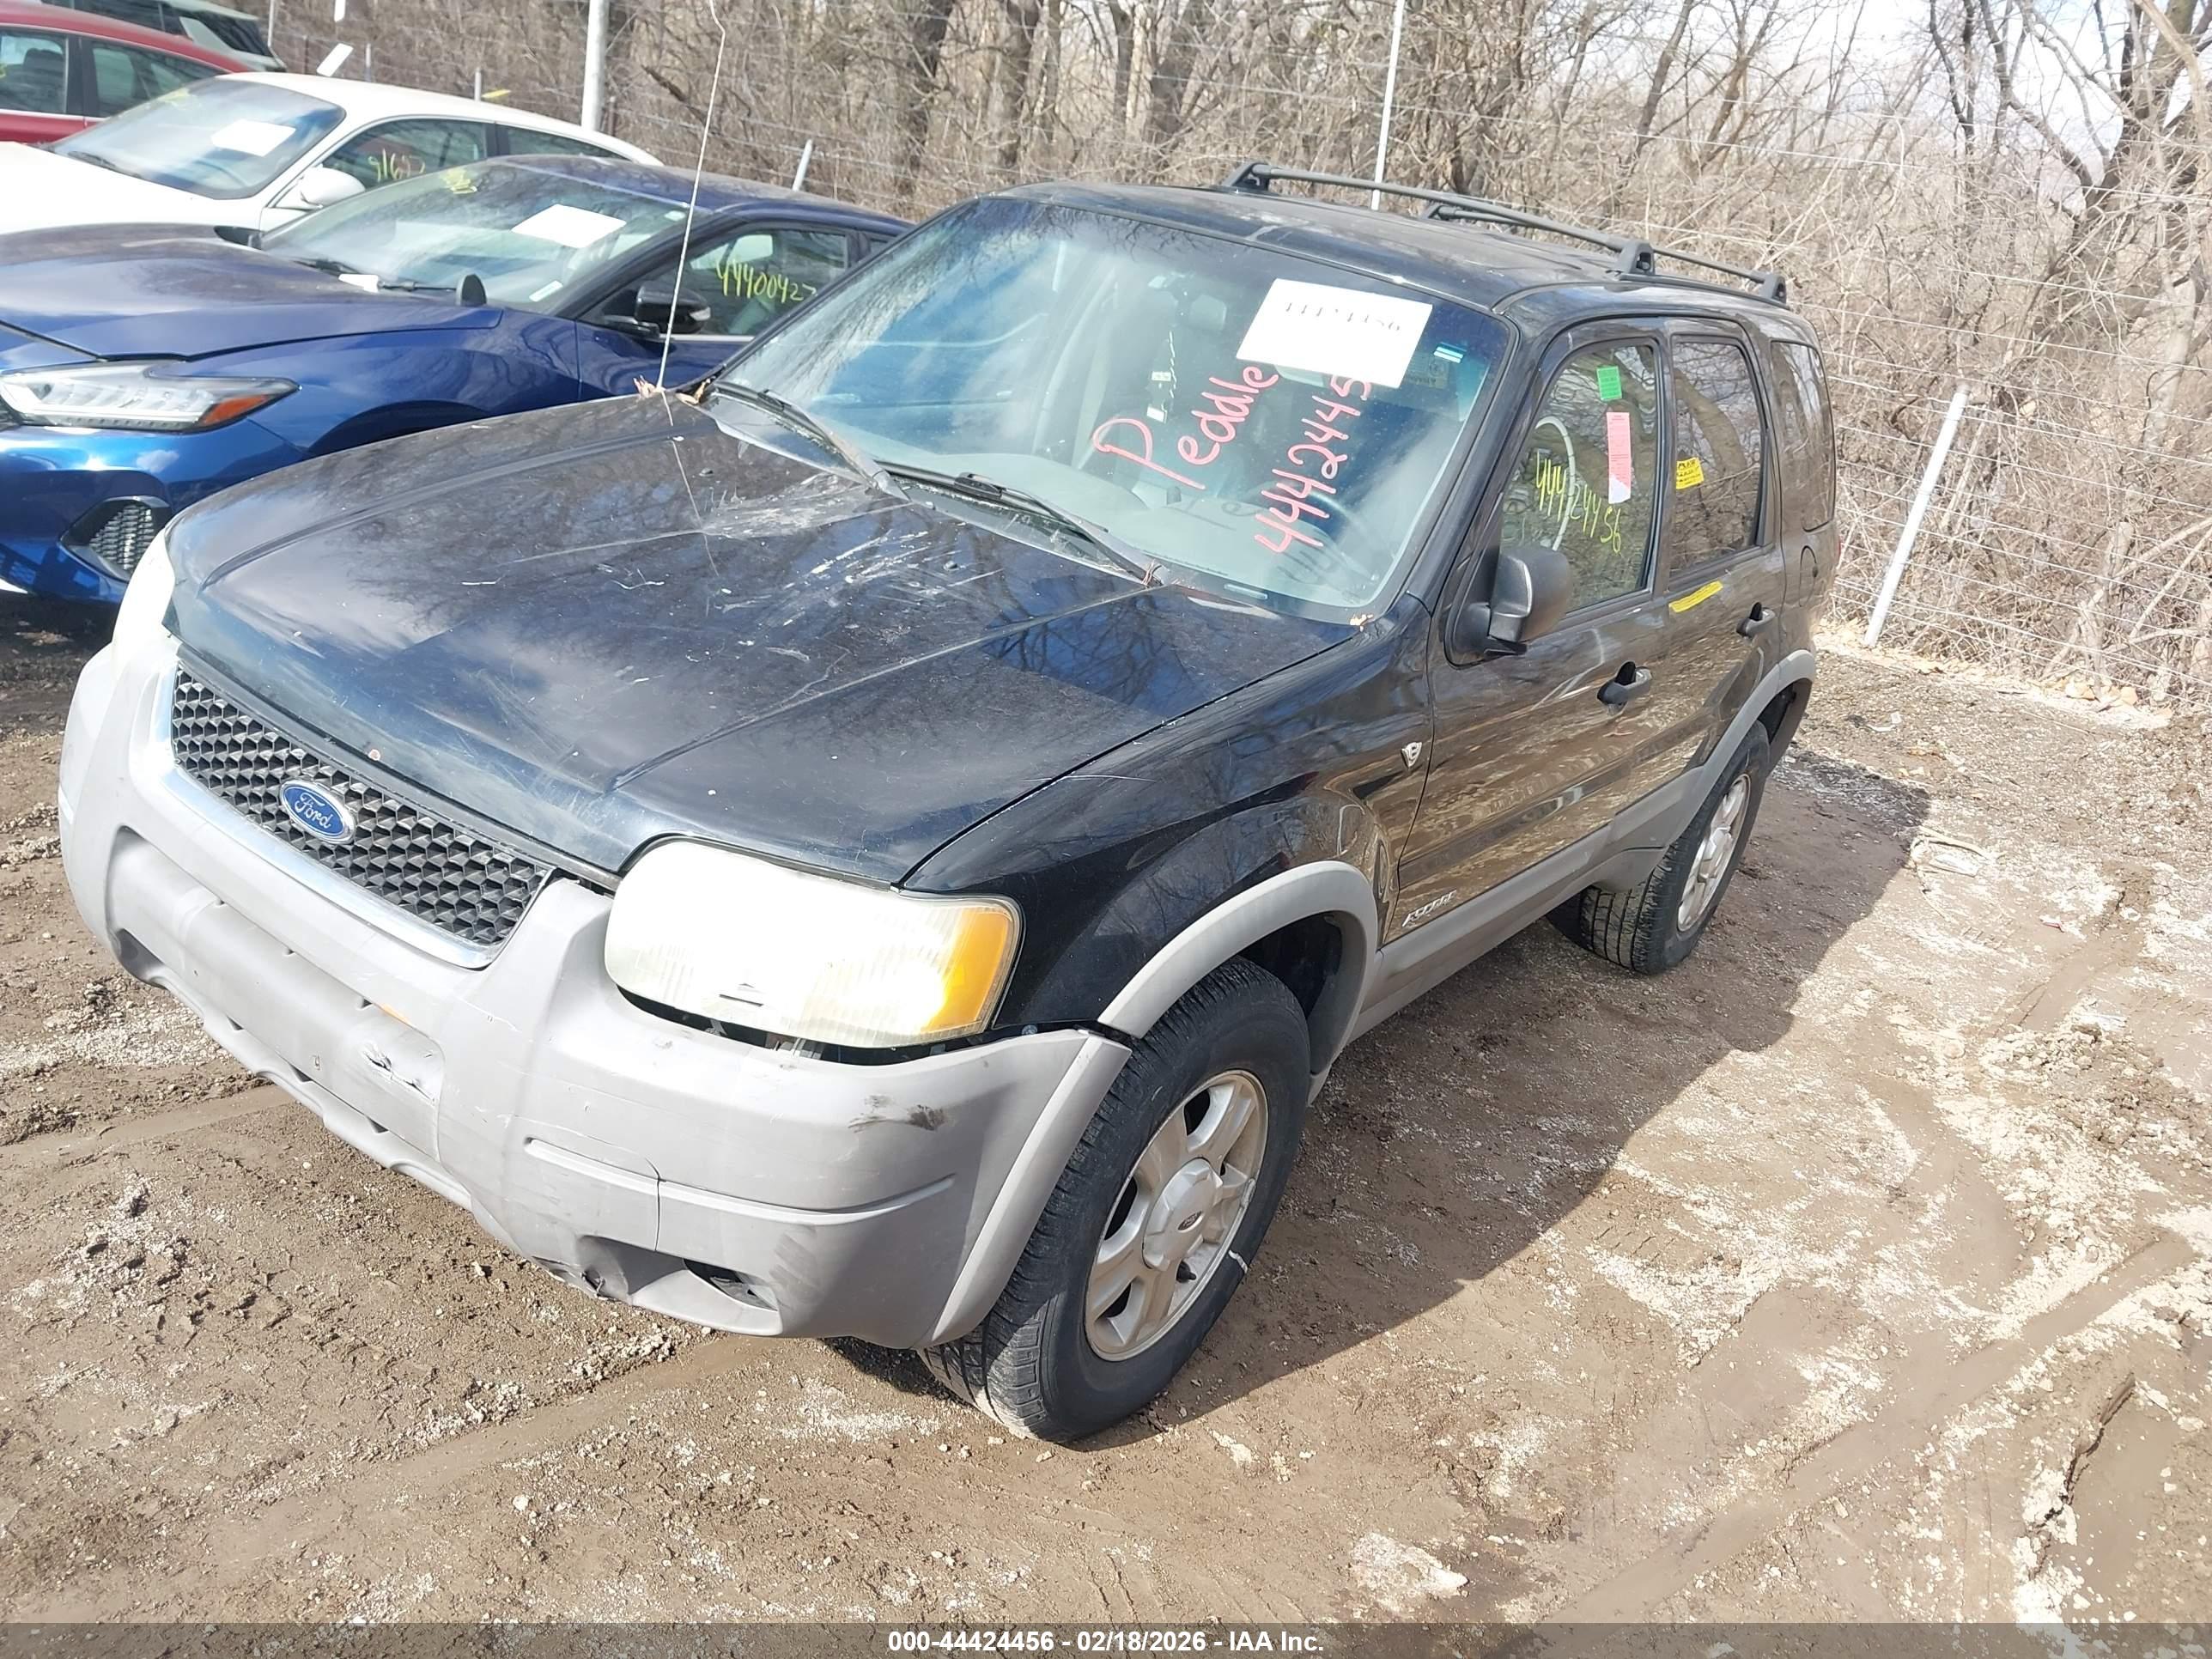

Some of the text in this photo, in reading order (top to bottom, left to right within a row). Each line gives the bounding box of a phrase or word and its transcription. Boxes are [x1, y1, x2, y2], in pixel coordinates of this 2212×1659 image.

[1091, 365, 1279, 490] Peddle
[1535, 448, 1622, 554] 44424456
[294, 791, 333, 830] Ford
